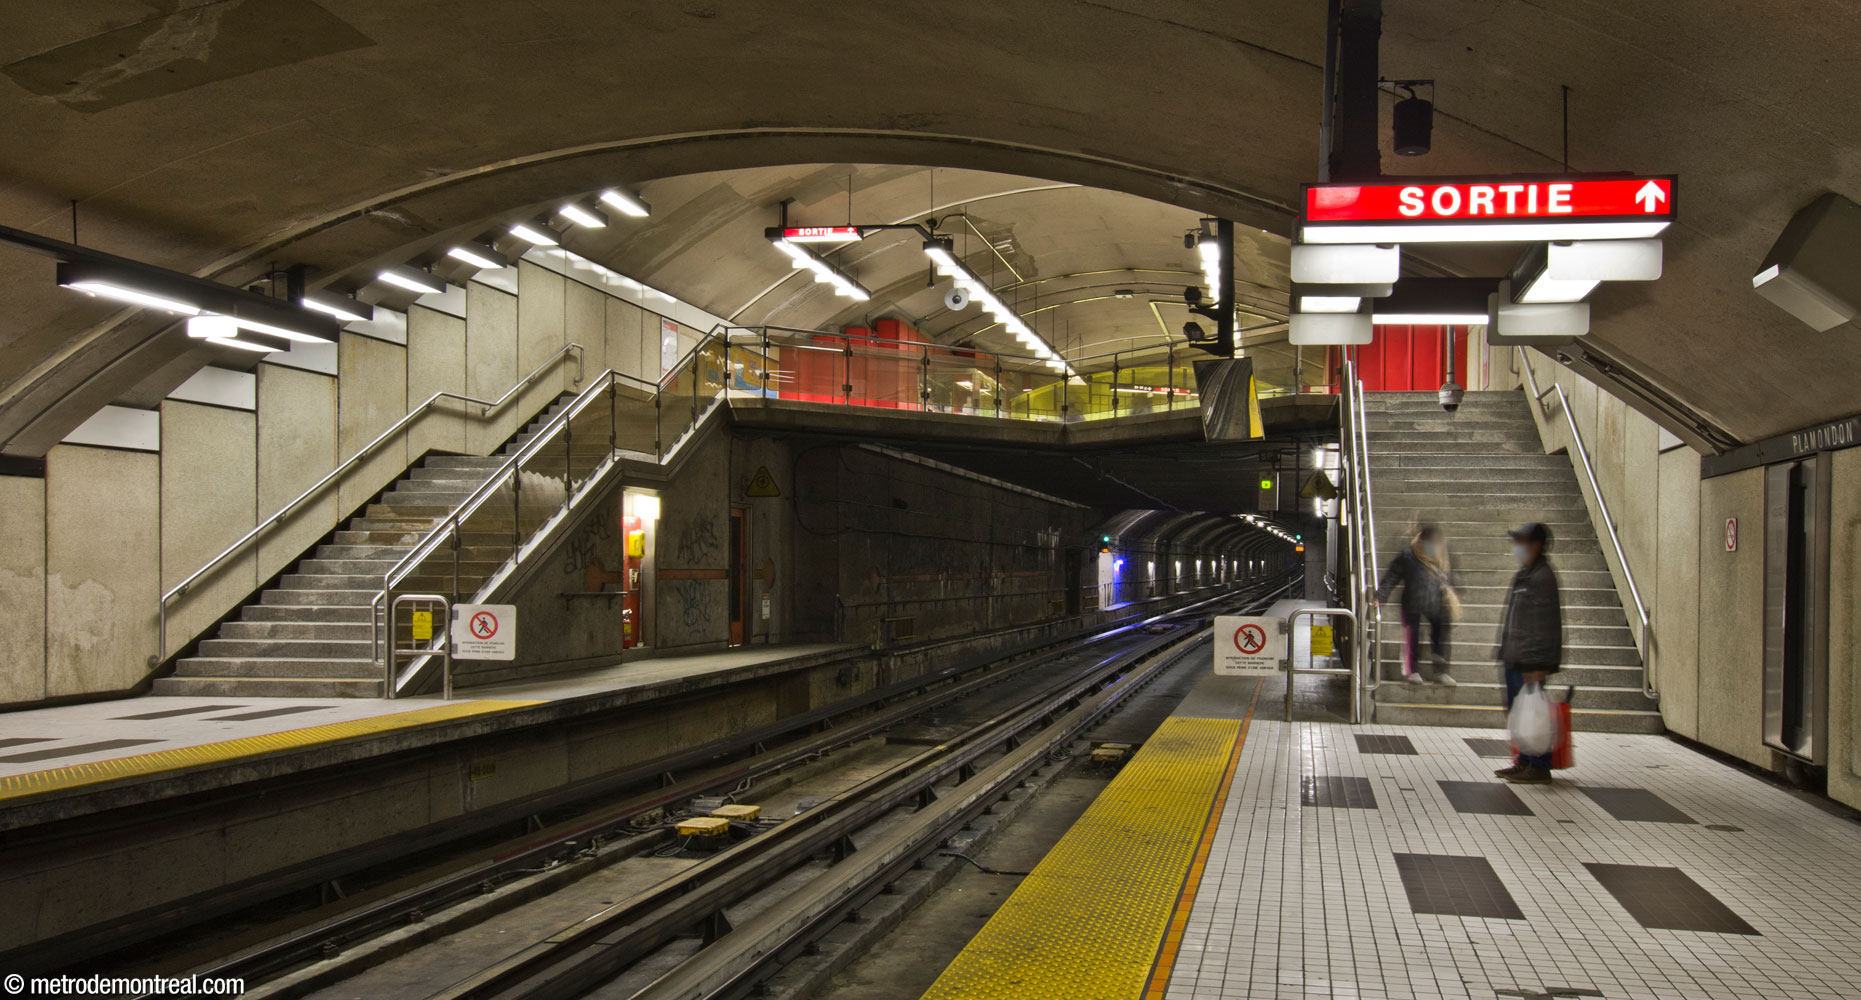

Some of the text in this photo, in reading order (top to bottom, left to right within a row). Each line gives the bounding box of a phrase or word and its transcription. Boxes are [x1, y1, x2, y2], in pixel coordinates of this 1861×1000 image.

[1398, 183, 1573, 217] SORTIE
[798, 227, 833, 236] SORTIE
[1792, 421, 1853, 454] PLAMONDON
